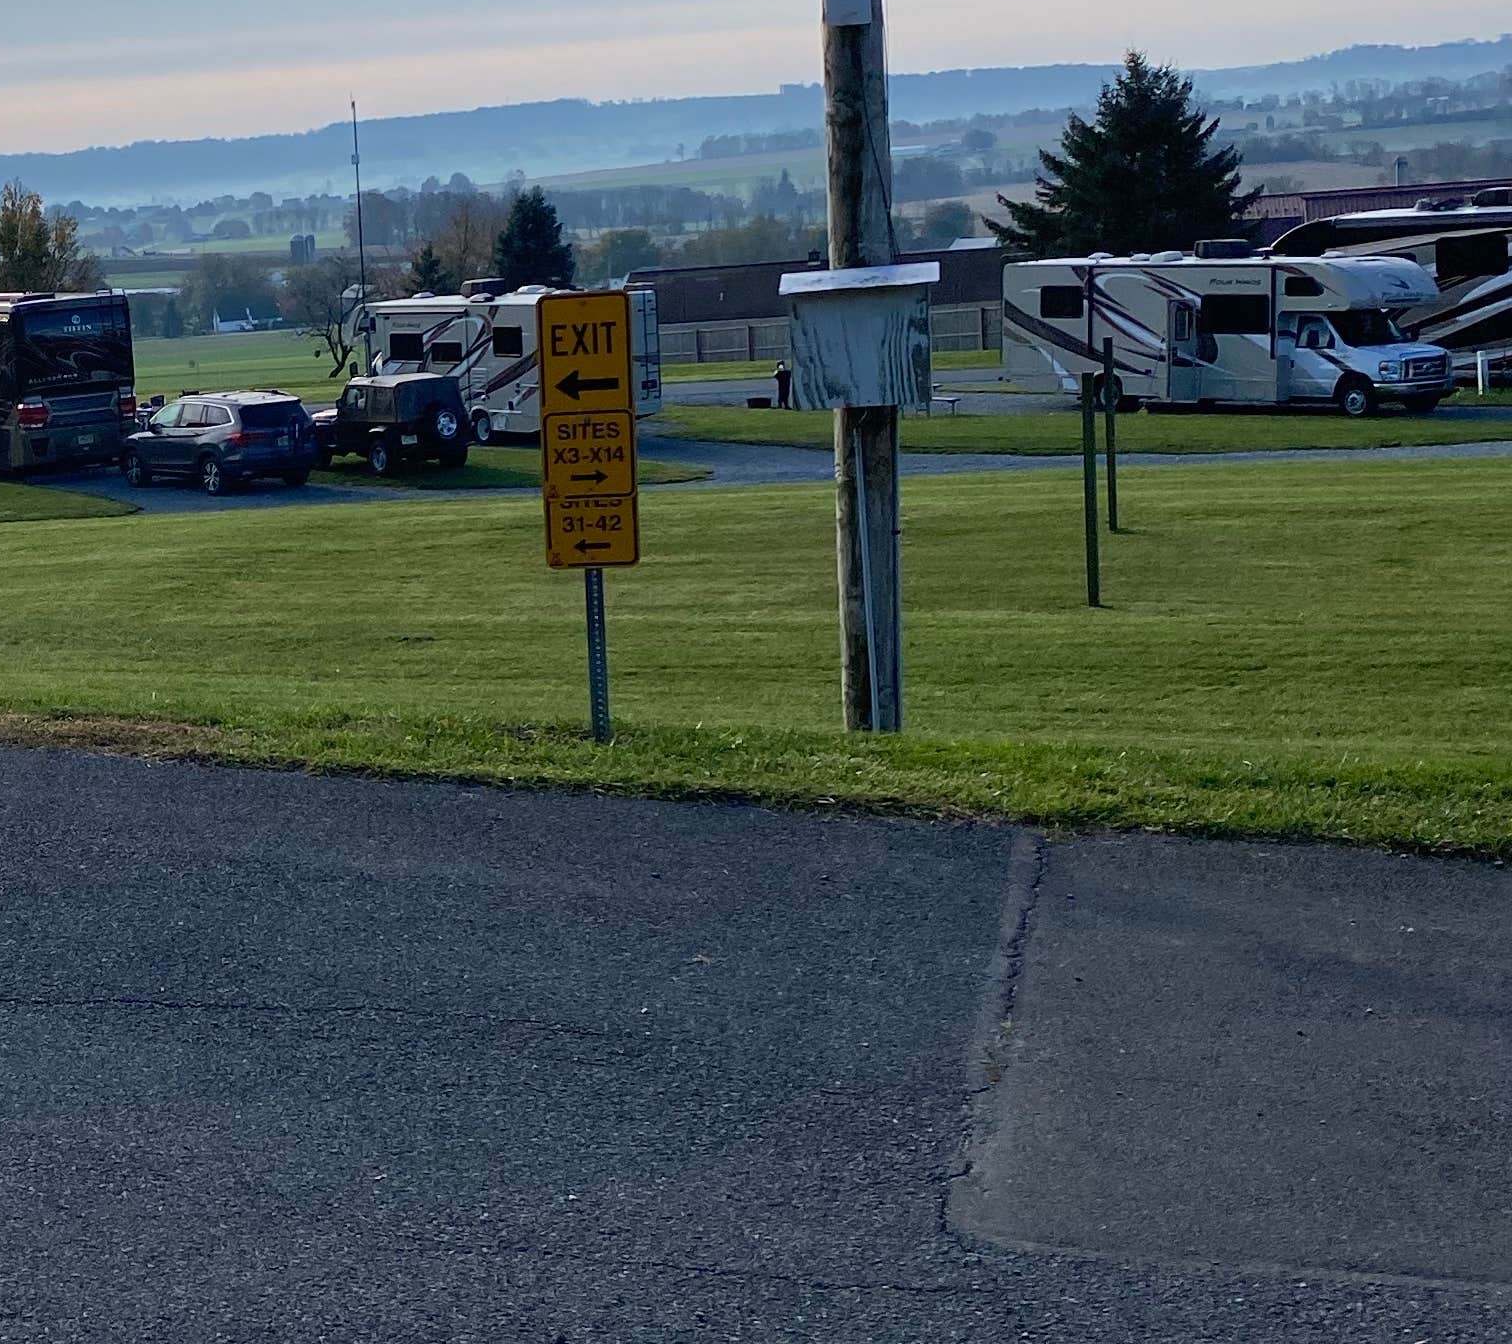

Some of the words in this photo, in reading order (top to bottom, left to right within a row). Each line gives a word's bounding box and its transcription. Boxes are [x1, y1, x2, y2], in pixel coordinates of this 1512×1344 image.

[550, 321, 617, 357] EXIT
[557, 422, 621, 441] SITES
[553, 445, 625, 465] X3-X14
[562, 514, 623, 533] 31-42
